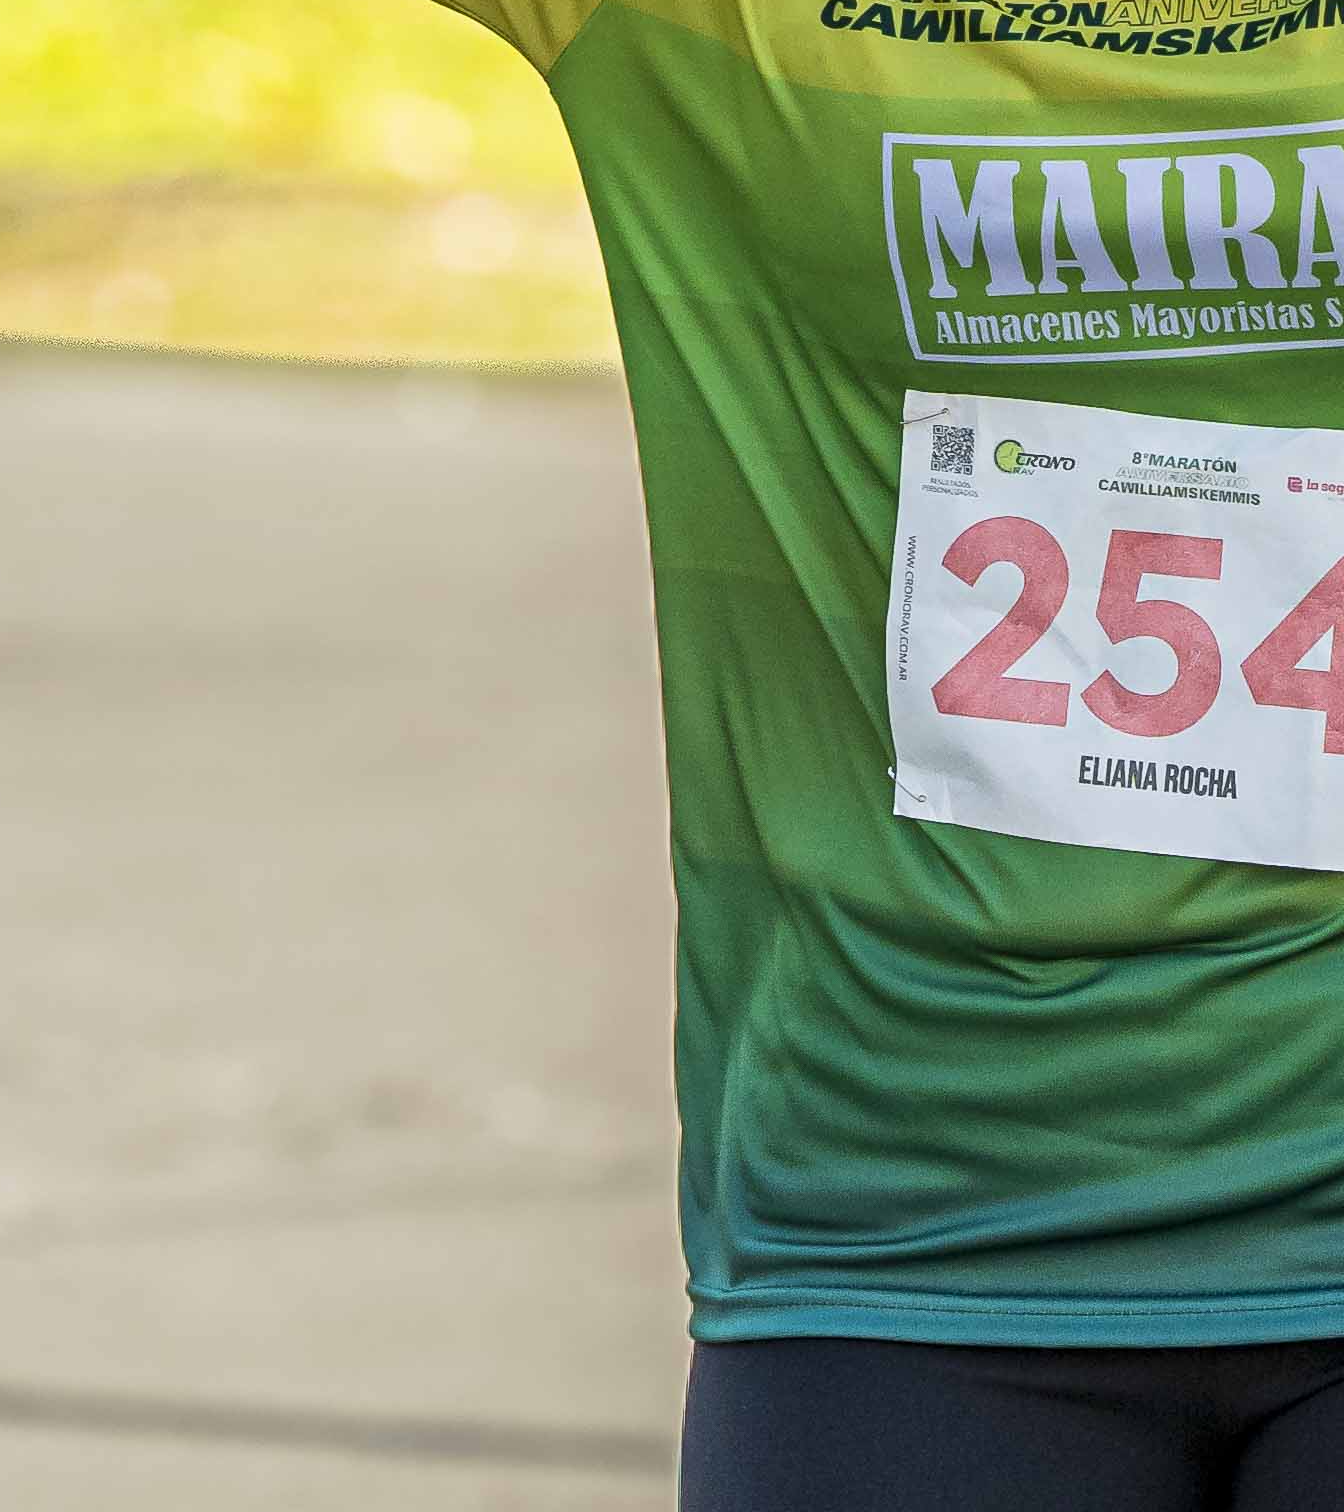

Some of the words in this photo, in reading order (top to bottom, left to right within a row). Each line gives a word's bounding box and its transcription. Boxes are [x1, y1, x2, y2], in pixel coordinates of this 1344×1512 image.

[935, 305, 1121, 344] Almacenes
[1129, 300, 1315, 340] Mayoristas
[1097, 479, 1261, 506] CAWILLIAMSKEMMIS
[899, 535, 917, 681] WWW.CRONORAV.COM.AR
[1078, 755, 1157, 792] ELIANA
[1164, 763, 1238, 800] ROCHA
